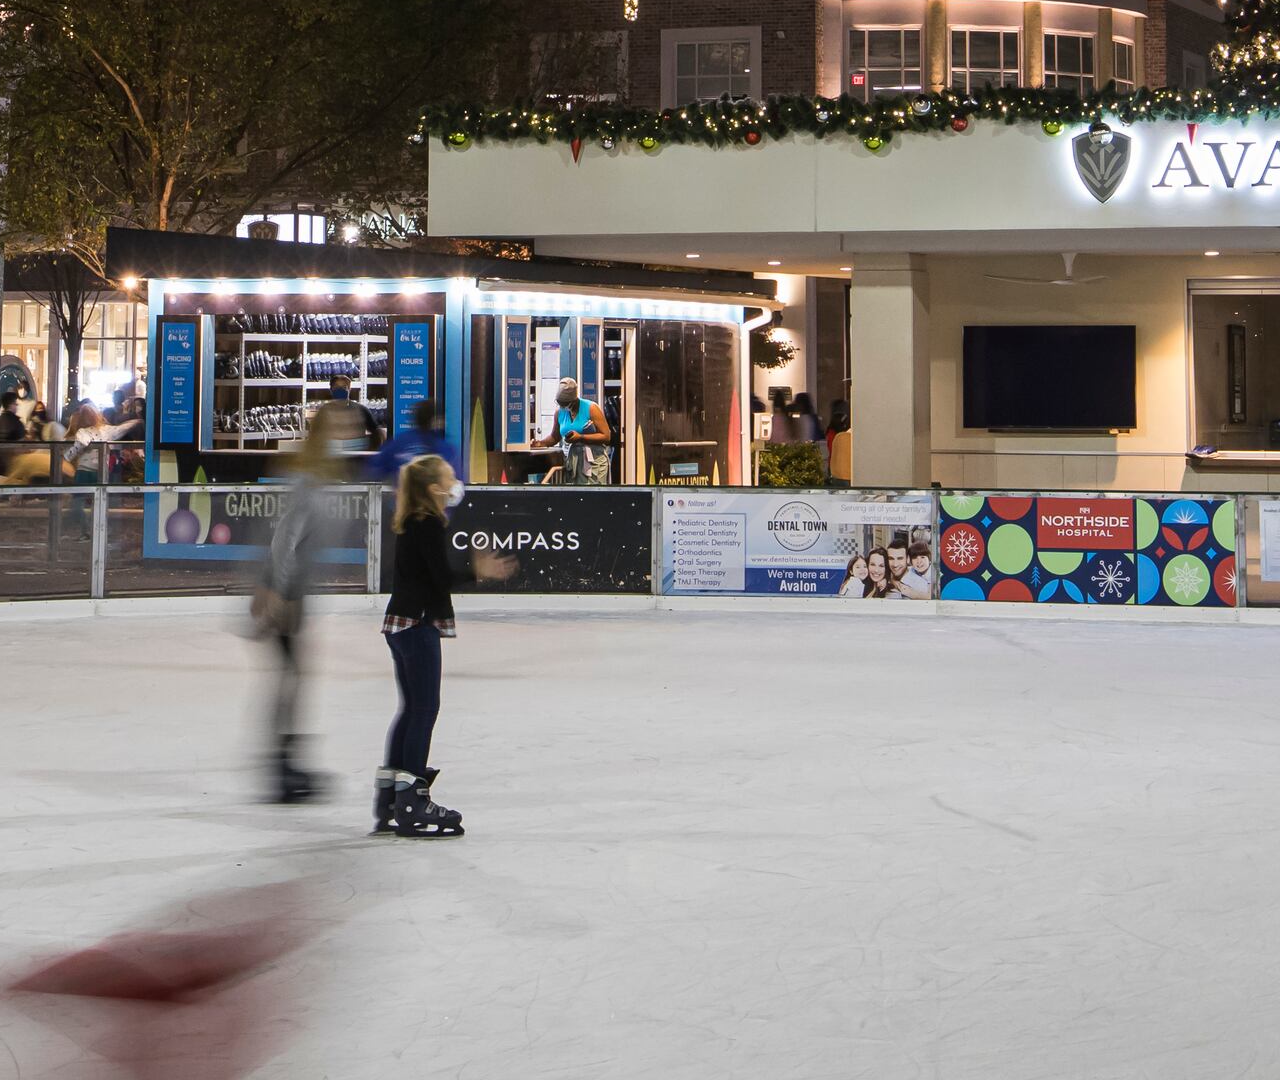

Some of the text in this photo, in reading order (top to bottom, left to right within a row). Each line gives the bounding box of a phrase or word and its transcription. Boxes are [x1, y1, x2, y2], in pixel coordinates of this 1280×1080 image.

[225, 493, 289, 517] GARDE
[708, 520, 738, 529] Dentistry
[767, 520, 828, 531] DENTAL TOWN
[1041, 515, 1130, 528] NORTHSIDE
[708, 529, 738, 538] Dentistry
[1057, 528, 1113, 537] HOSPITAL
[451, 531, 580, 551] COMPASS
[677, 538, 741, 548] Cosmetic Dentistry
[677, 548, 722, 556] Orthodontics
[677, 558, 722, 568] Oral Surgery
[677, 568, 726, 578] Sleep Therapy
[767, 569, 829, 580] We're here at
[693, 578, 721, 587] Therapy
[780, 580, 817, 592] Avalon
